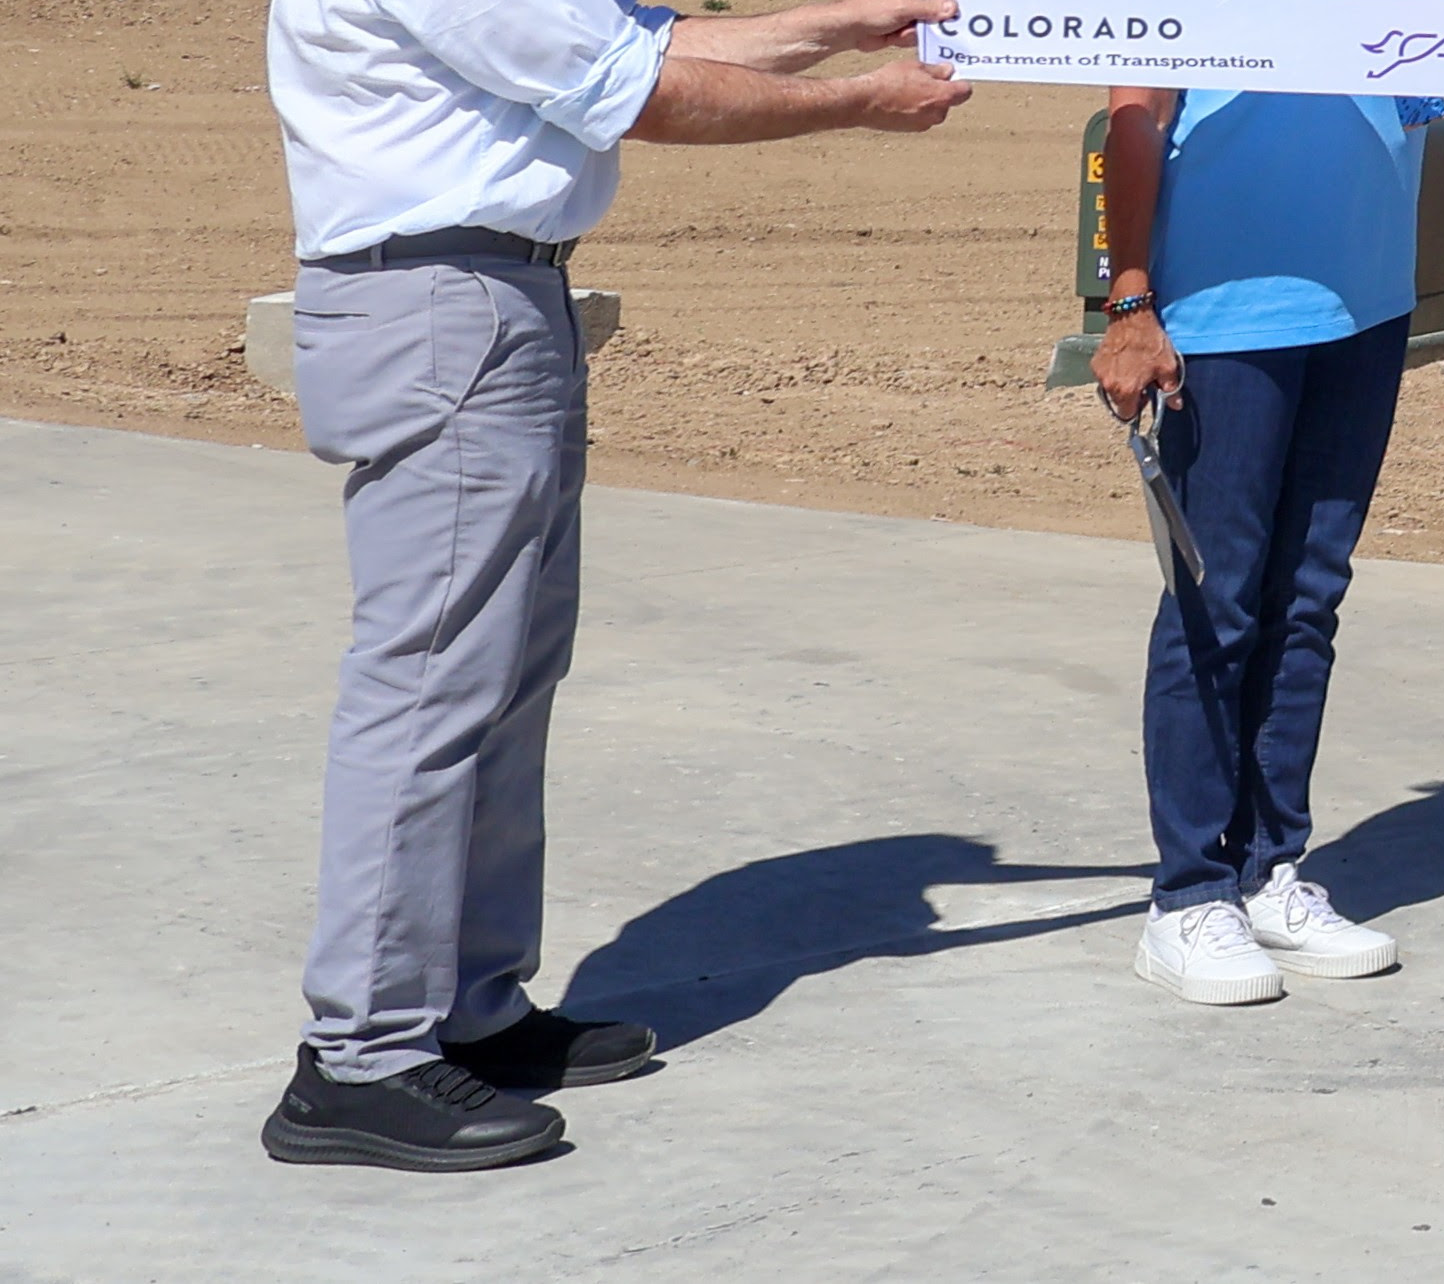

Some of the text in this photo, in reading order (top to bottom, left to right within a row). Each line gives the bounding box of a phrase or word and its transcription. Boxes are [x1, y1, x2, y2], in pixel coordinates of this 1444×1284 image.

[938, 14, 1182, 40] COLORADO
[938, 45, 1274, 71] Department of Transportation
